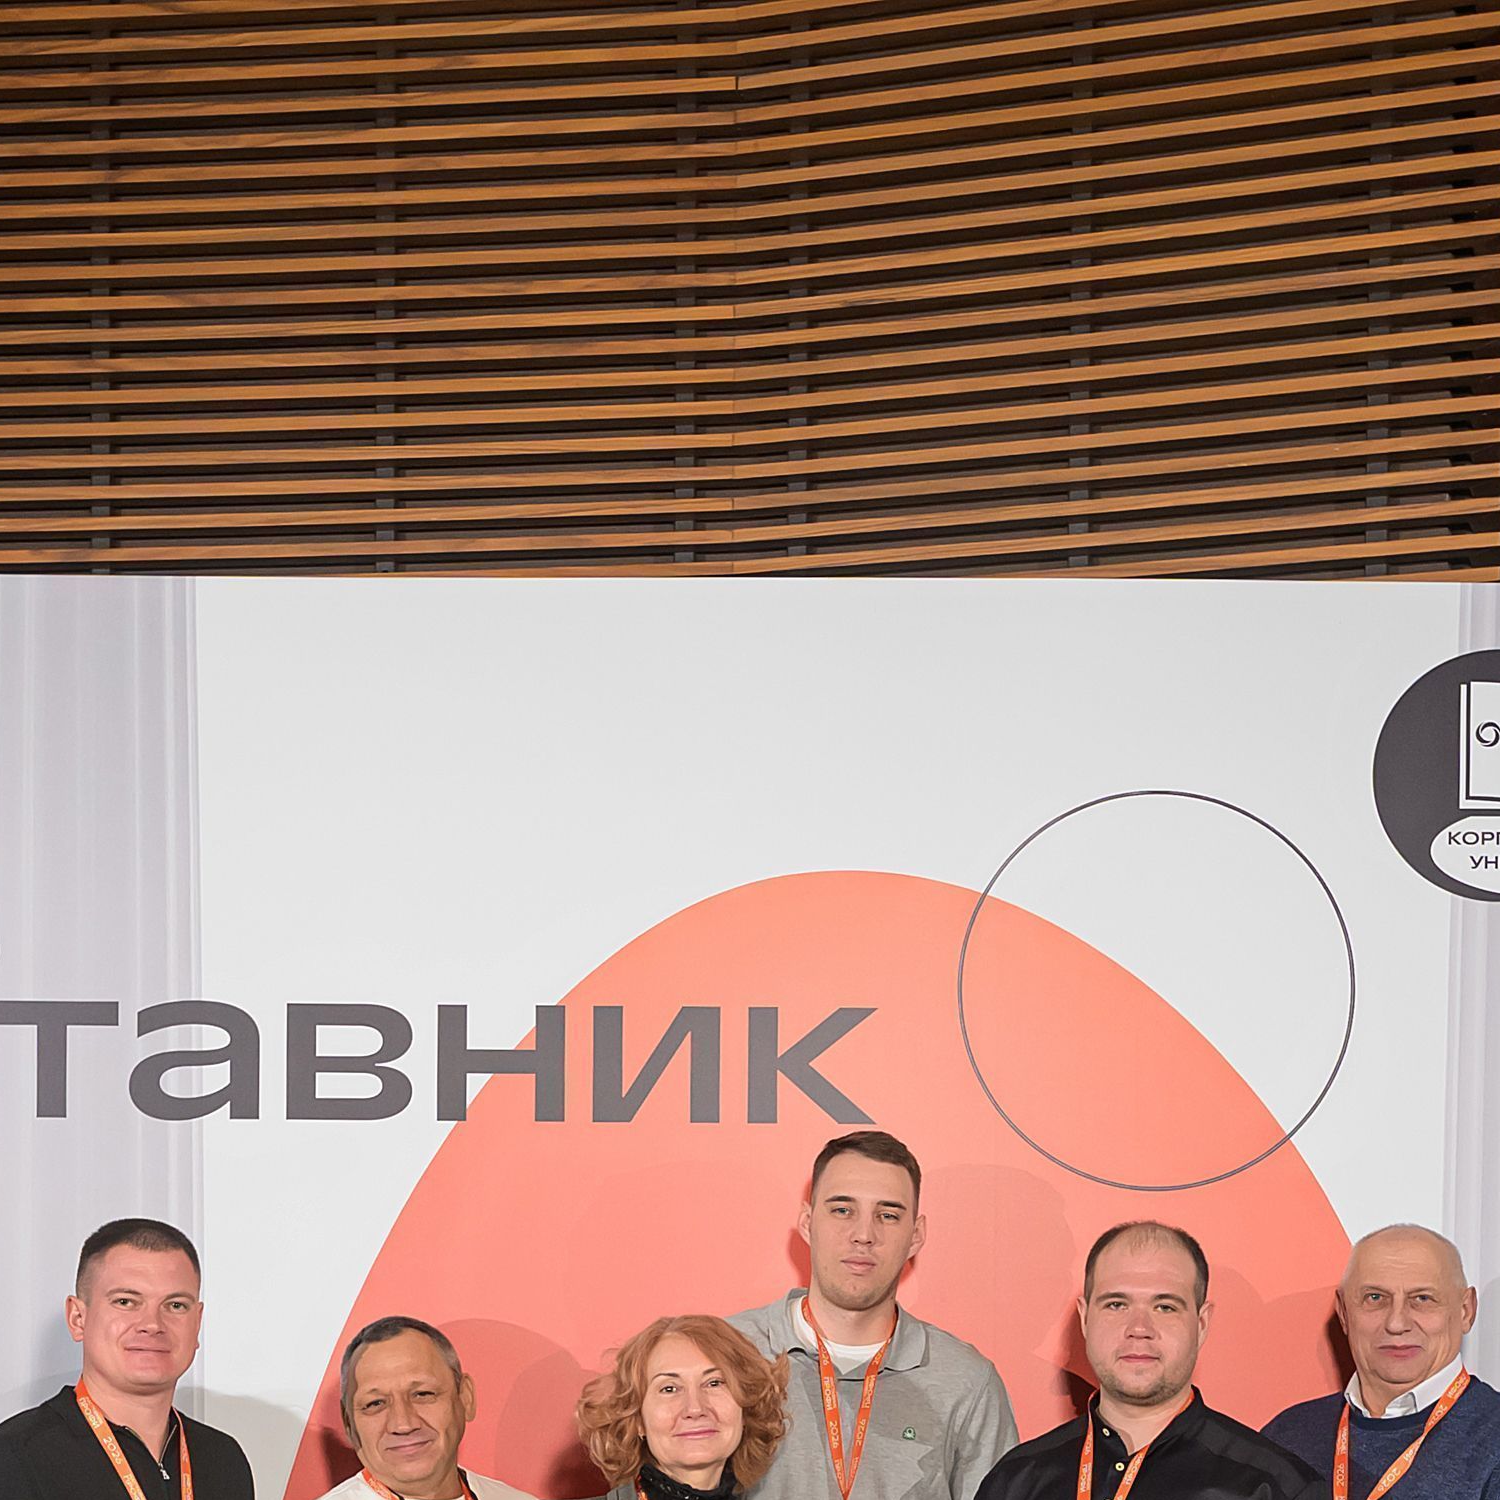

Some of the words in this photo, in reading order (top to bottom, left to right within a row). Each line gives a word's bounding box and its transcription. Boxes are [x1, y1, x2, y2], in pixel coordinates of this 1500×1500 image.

[829, 1421, 839, 1449] 2026
[855, 1418, 866, 1446] 2026
[103, 1436, 122, 1465] 2026
[1336, 1464, 1345, 1486] 2026
[1378, 1467, 1401, 1492] 2026
